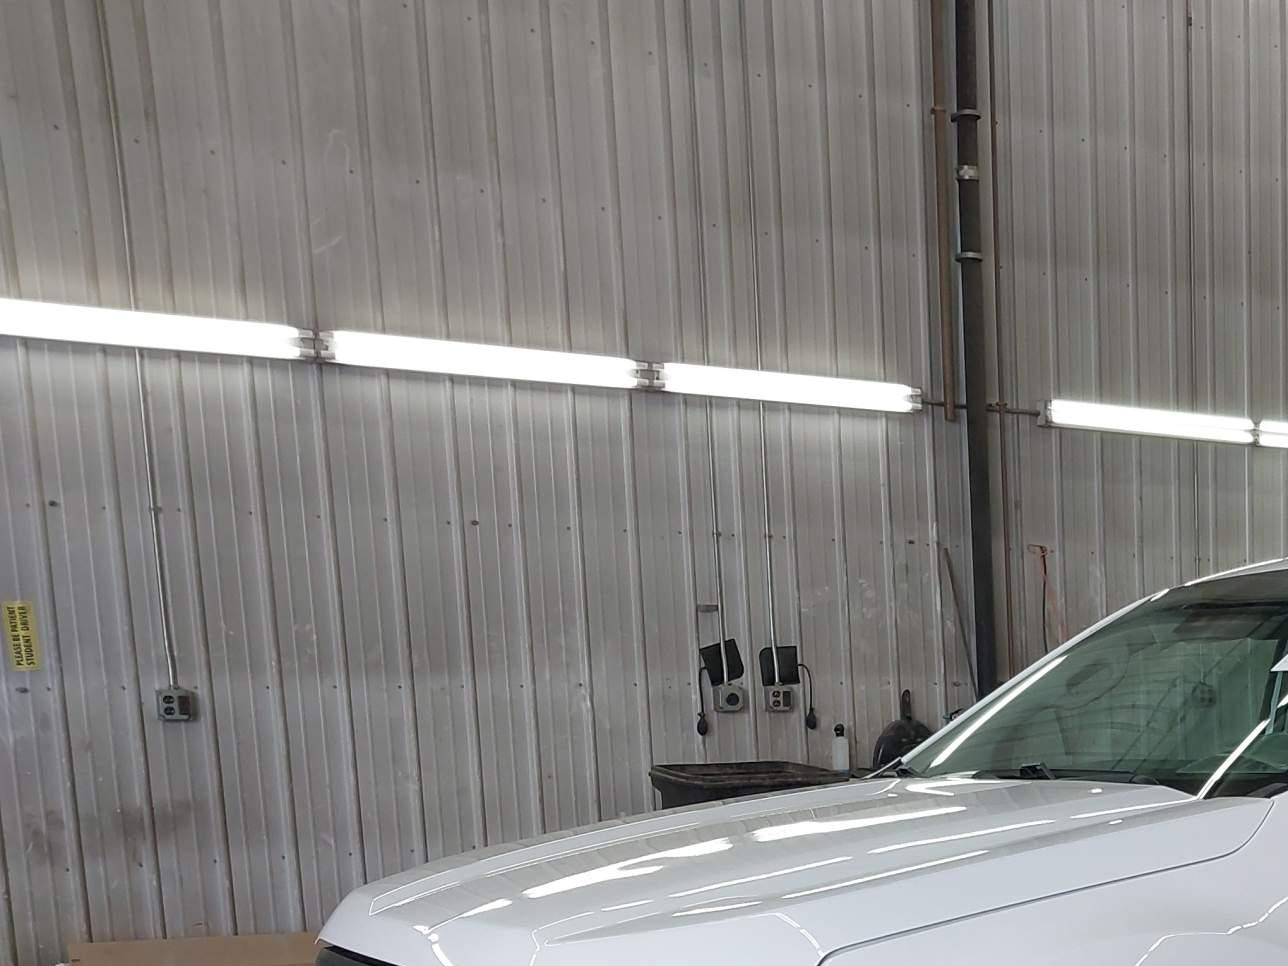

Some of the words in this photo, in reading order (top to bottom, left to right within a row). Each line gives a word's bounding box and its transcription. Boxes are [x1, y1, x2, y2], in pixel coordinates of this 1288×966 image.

[7, 606, 18, 632] PATIENT
[18, 606, 30, 631] DRIVER
[13, 643, 24, 665] PLEASE
[22, 635, 35, 665] STUDENT
